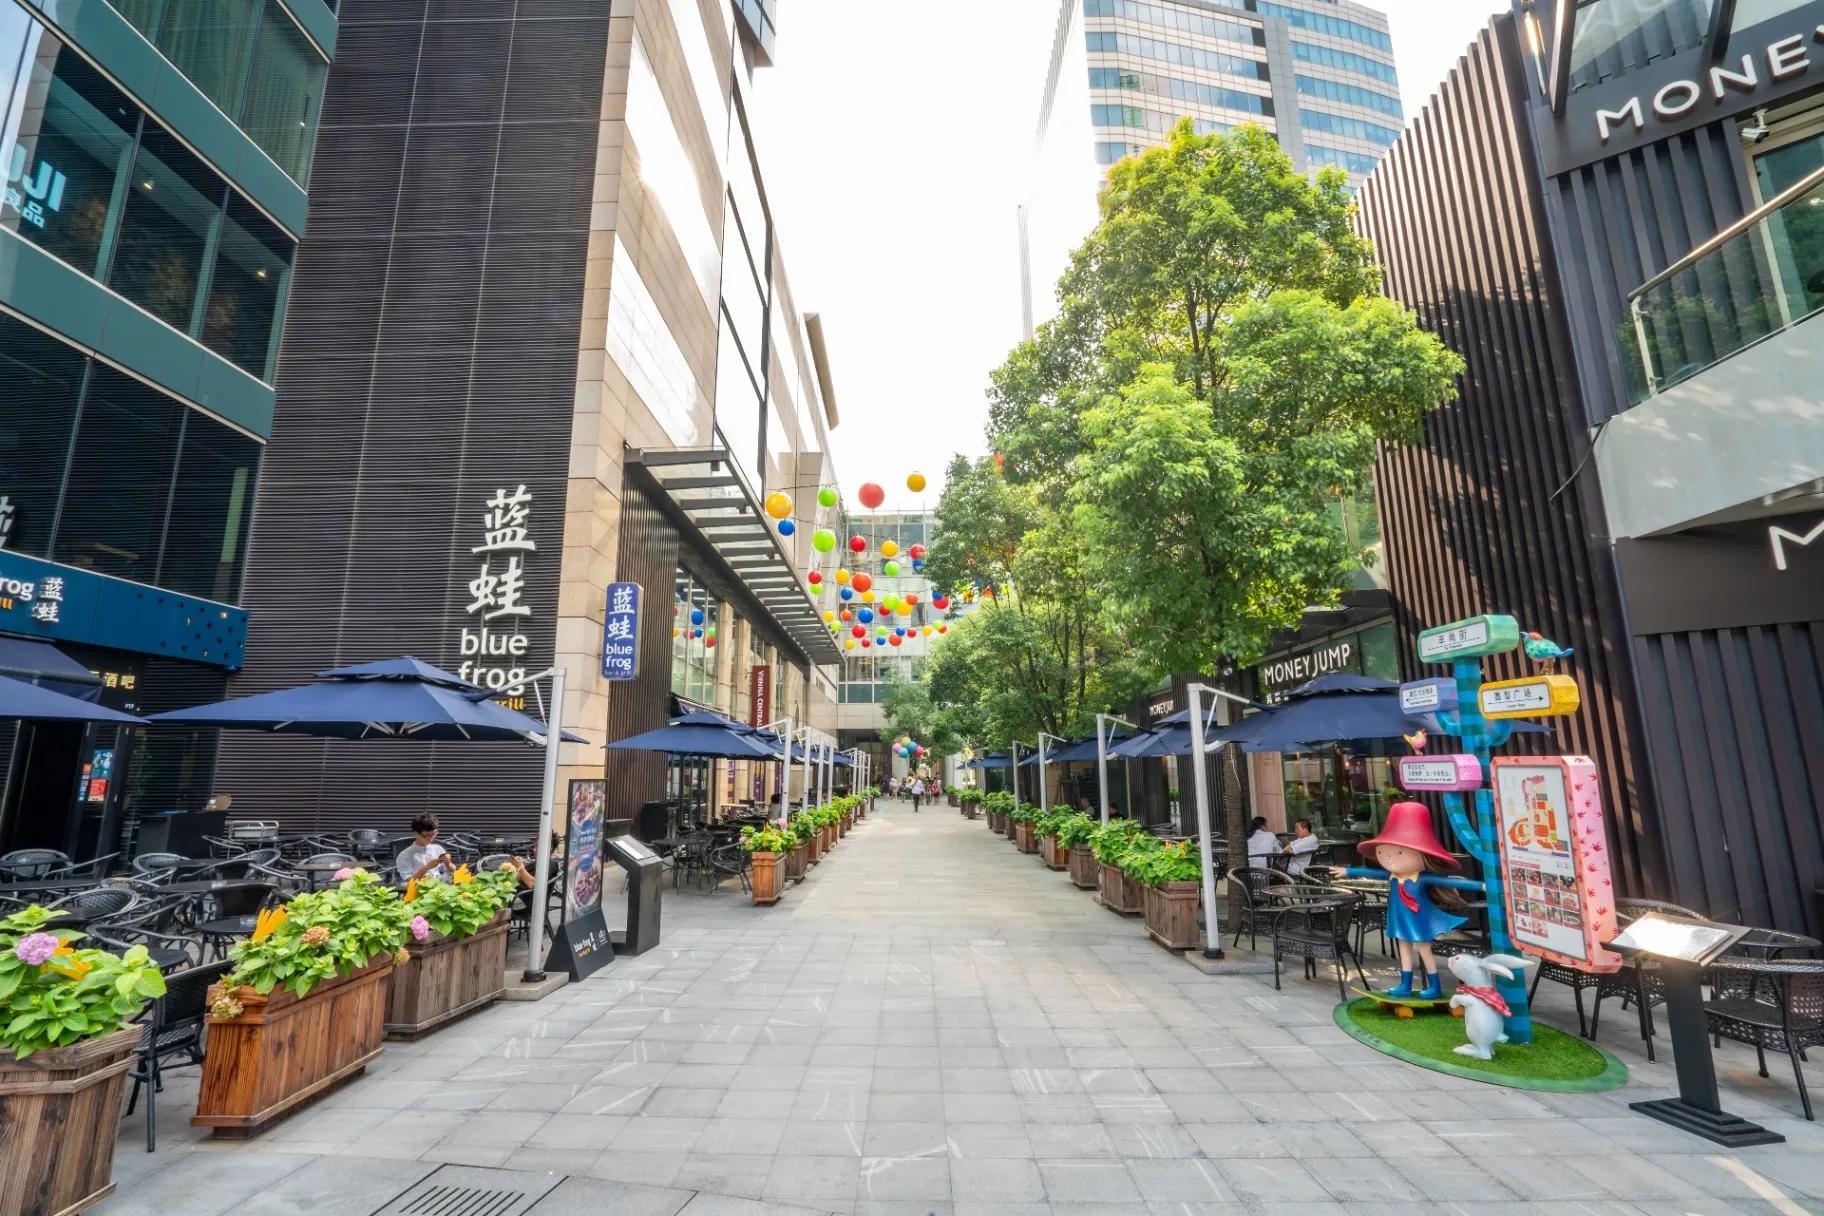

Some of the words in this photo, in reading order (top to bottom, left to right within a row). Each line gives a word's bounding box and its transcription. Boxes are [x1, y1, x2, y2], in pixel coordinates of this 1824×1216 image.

[1596, 25, 1824, 140] MONE
[465, 484, 537, 621] 蓝蛙
[0, 572, 35, 601] rog
[31, 576, 64, 623] 蓝蛙
[608, 586, 635, 640] 蓝蛙
[460, 628, 528, 656] blue
[606, 642, 633, 655] blue
[606, 656, 632, 670] frog
[90, 670, 135, 690] 酒吧
[458, 660, 527, 697] frog
[757, 671, 765, 697] VIENNA
